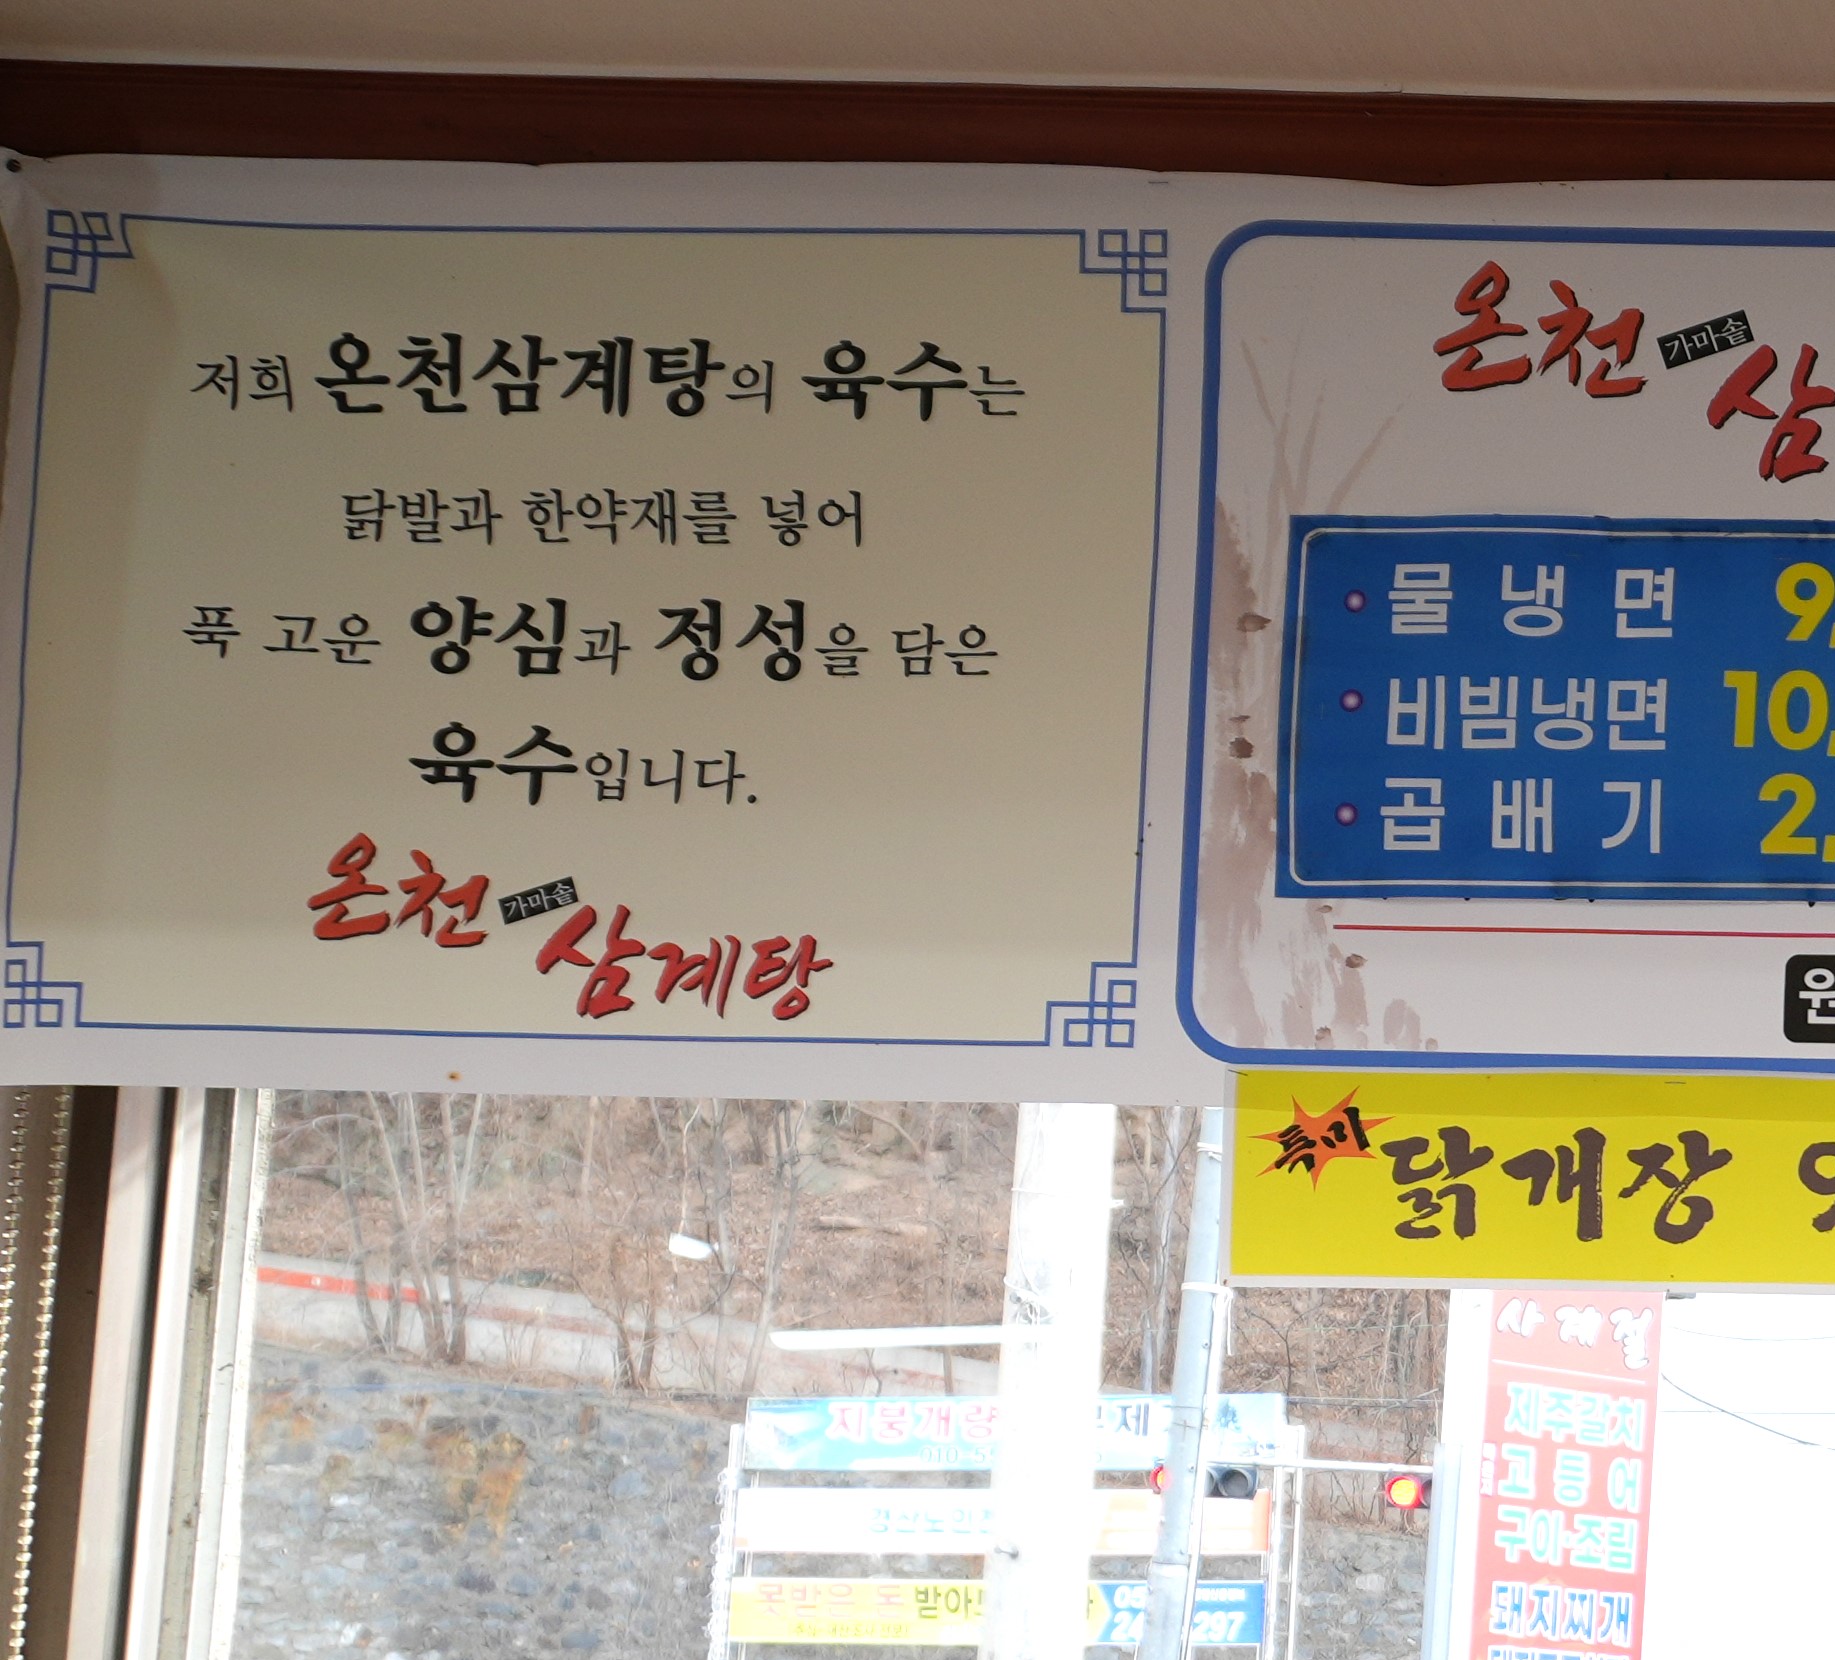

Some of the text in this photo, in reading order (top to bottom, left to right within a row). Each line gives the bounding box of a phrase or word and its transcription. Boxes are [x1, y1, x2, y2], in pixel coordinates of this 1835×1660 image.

[1433, 261, 1648, 398] 온천
[1662, 316, 1752, 365] 가마솥
[191, 332, 1025, 421] 저희 온천삼계탕의 육수는
[342, 488, 861, 547] 닭발과 한약재를 넣어
[182, 596, 998, 681] 푹 고운 양심과 정성을 담은
[1384, 673, 1669, 753] 비빔냉면
[408, 722, 757, 806] 육수입니다.
[307, 832, 832, 1021] 온천 가마솥 삼계탕
[1380, 1126, 1731, 1245] 닭개장
[1505, 1382, 1645, 1452] 제주갈치
